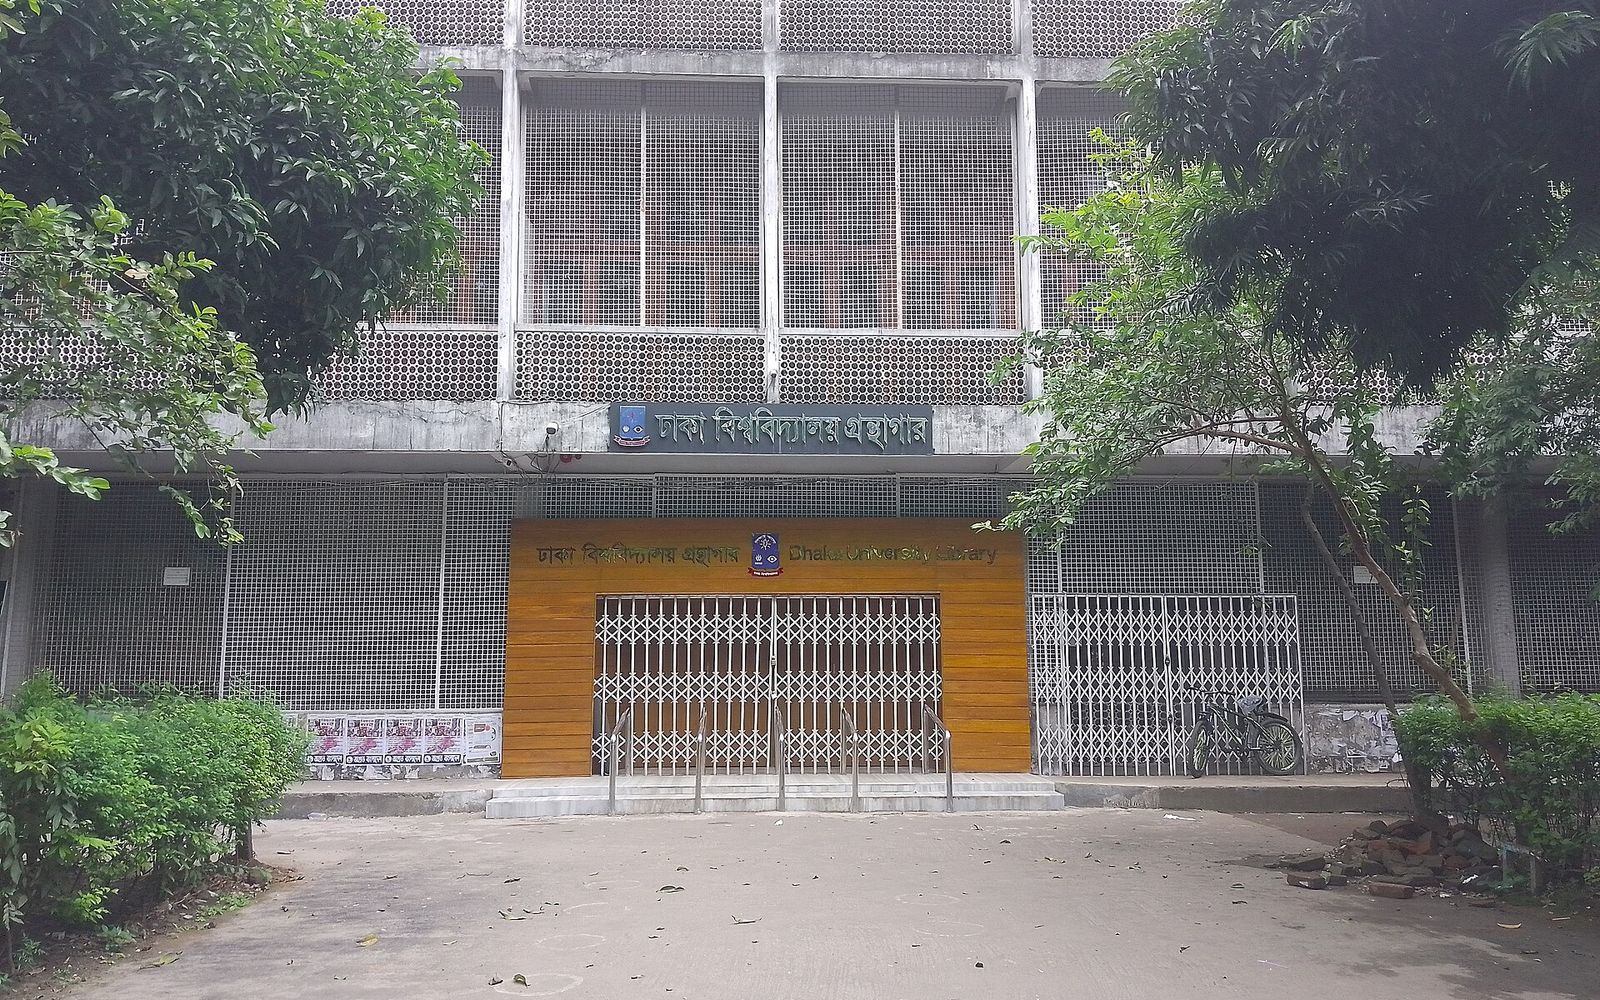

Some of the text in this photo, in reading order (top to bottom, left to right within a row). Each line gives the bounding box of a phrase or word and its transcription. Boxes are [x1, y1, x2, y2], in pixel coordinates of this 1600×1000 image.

[655, 406, 929, 449] ঢাকা বিশ্ববিদ্যালয় গ্রন্থাগার
[536, 546, 576, 565] ঢাকা
[682, 545, 739, 568] গ্রন্থাগার
[789, 545, 996, 565] Dhaka University Library
